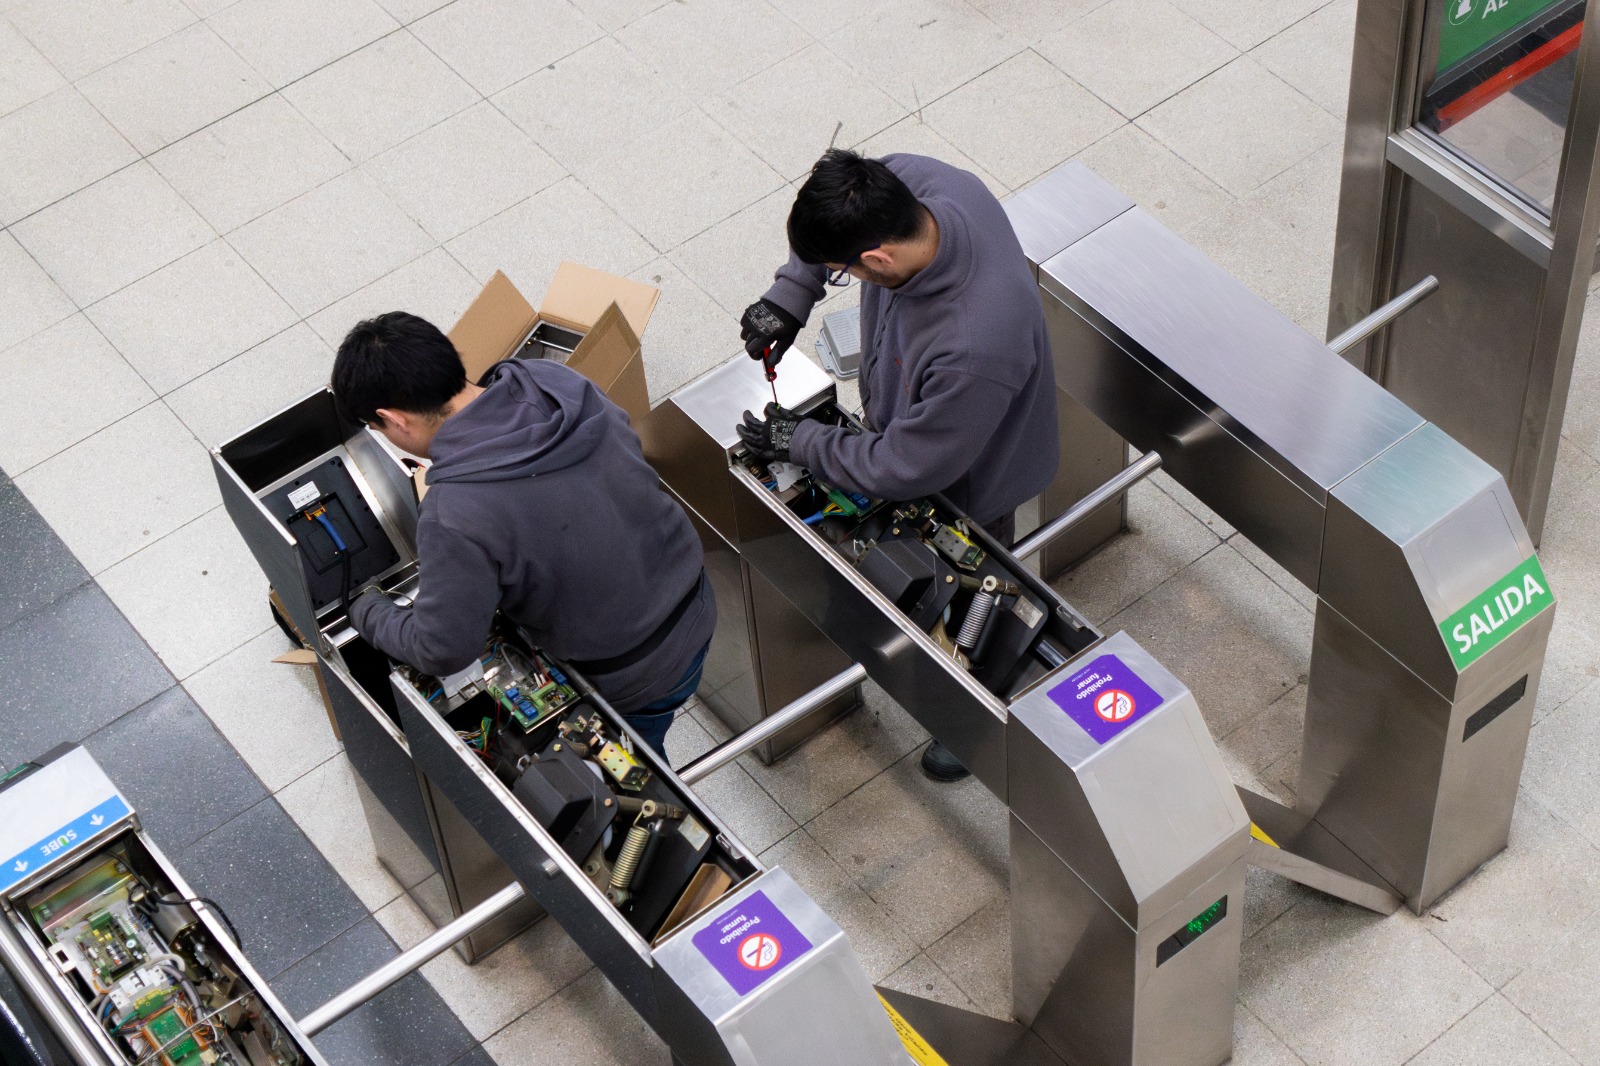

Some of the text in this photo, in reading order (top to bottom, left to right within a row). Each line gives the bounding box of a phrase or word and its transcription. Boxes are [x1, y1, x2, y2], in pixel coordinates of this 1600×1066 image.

[1452, 573, 1545, 654] SALIDA
[1076, 673, 1100, 690] fumar
[1076, 674, 1113, 700] Prohibido
[39, 829, 77, 857] SUBE
[719, 916, 761, 945] Prohibido
